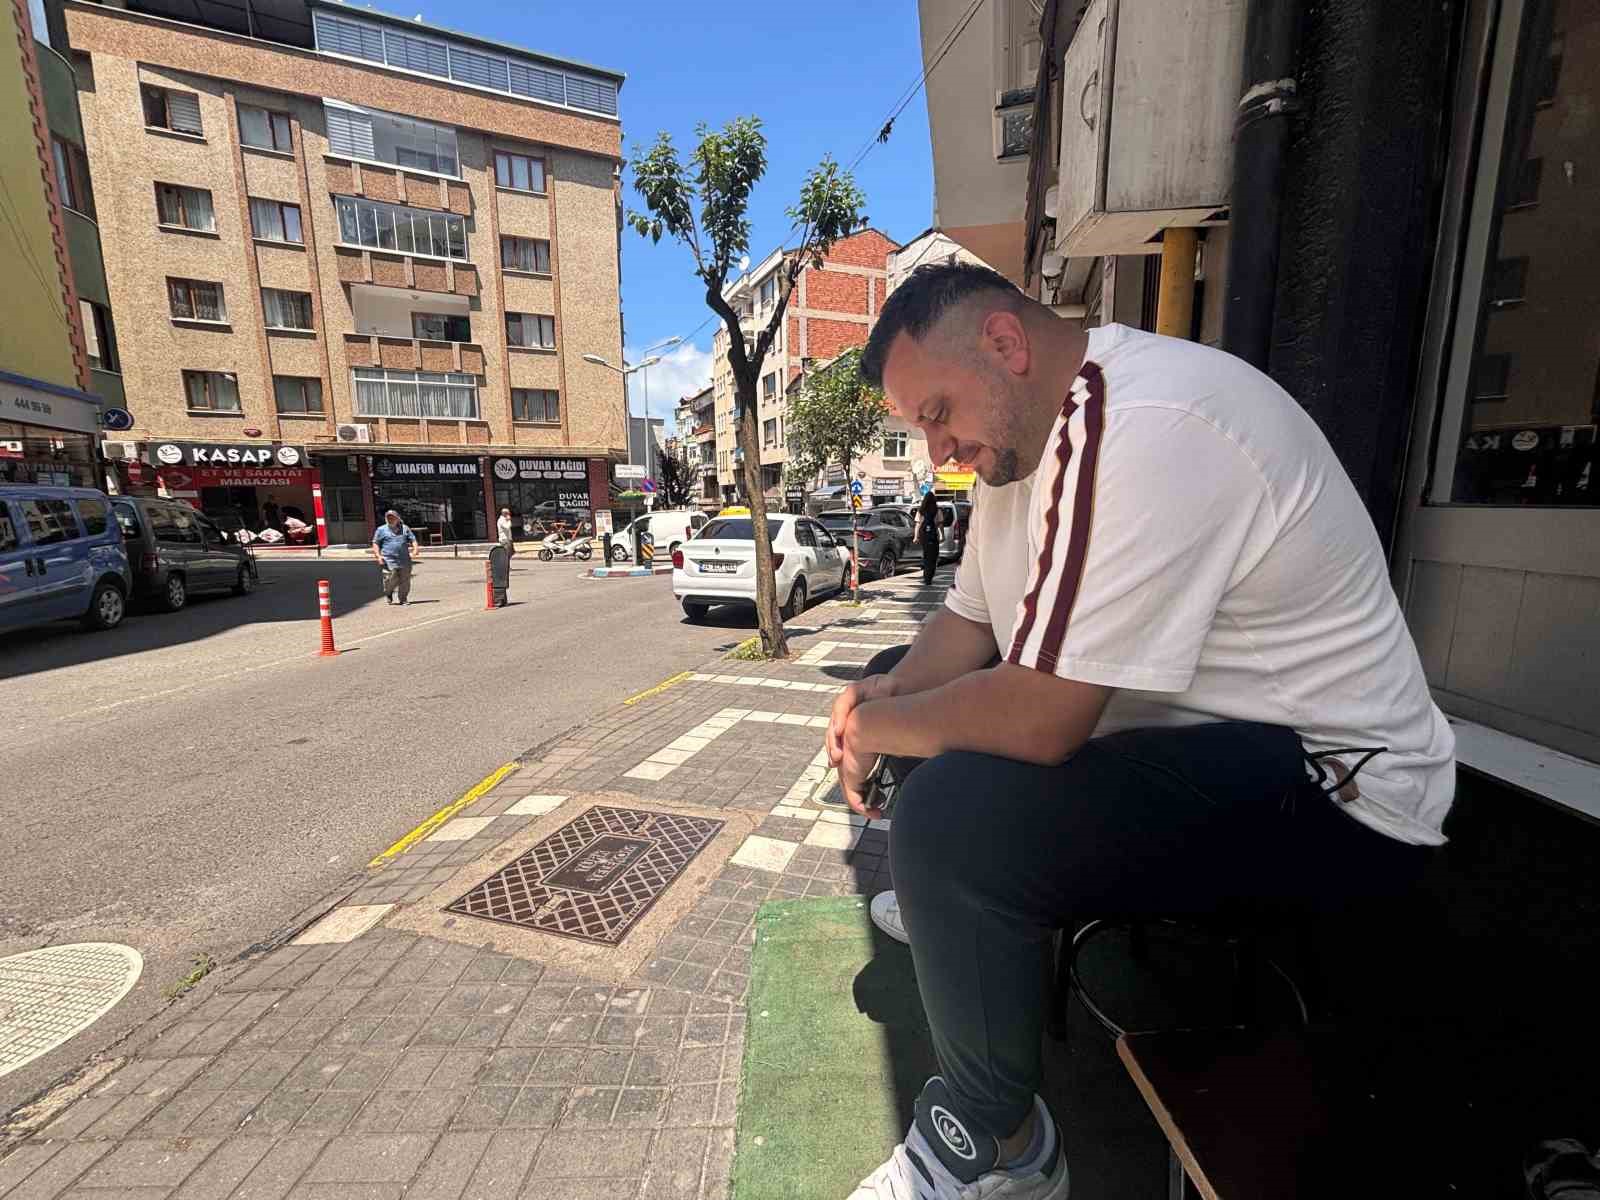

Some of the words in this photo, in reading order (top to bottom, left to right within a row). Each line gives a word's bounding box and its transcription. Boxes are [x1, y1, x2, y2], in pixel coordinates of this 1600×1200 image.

[193, 448, 272, 463] KASAP
[438, 463, 477, 474] HAKTAN
[519, 459, 552, 471] DUVAR
[224, 469, 242, 478] VE
[245, 469, 304, 478] SAKATAT
[559, 492, 590, 500] DUVAR
